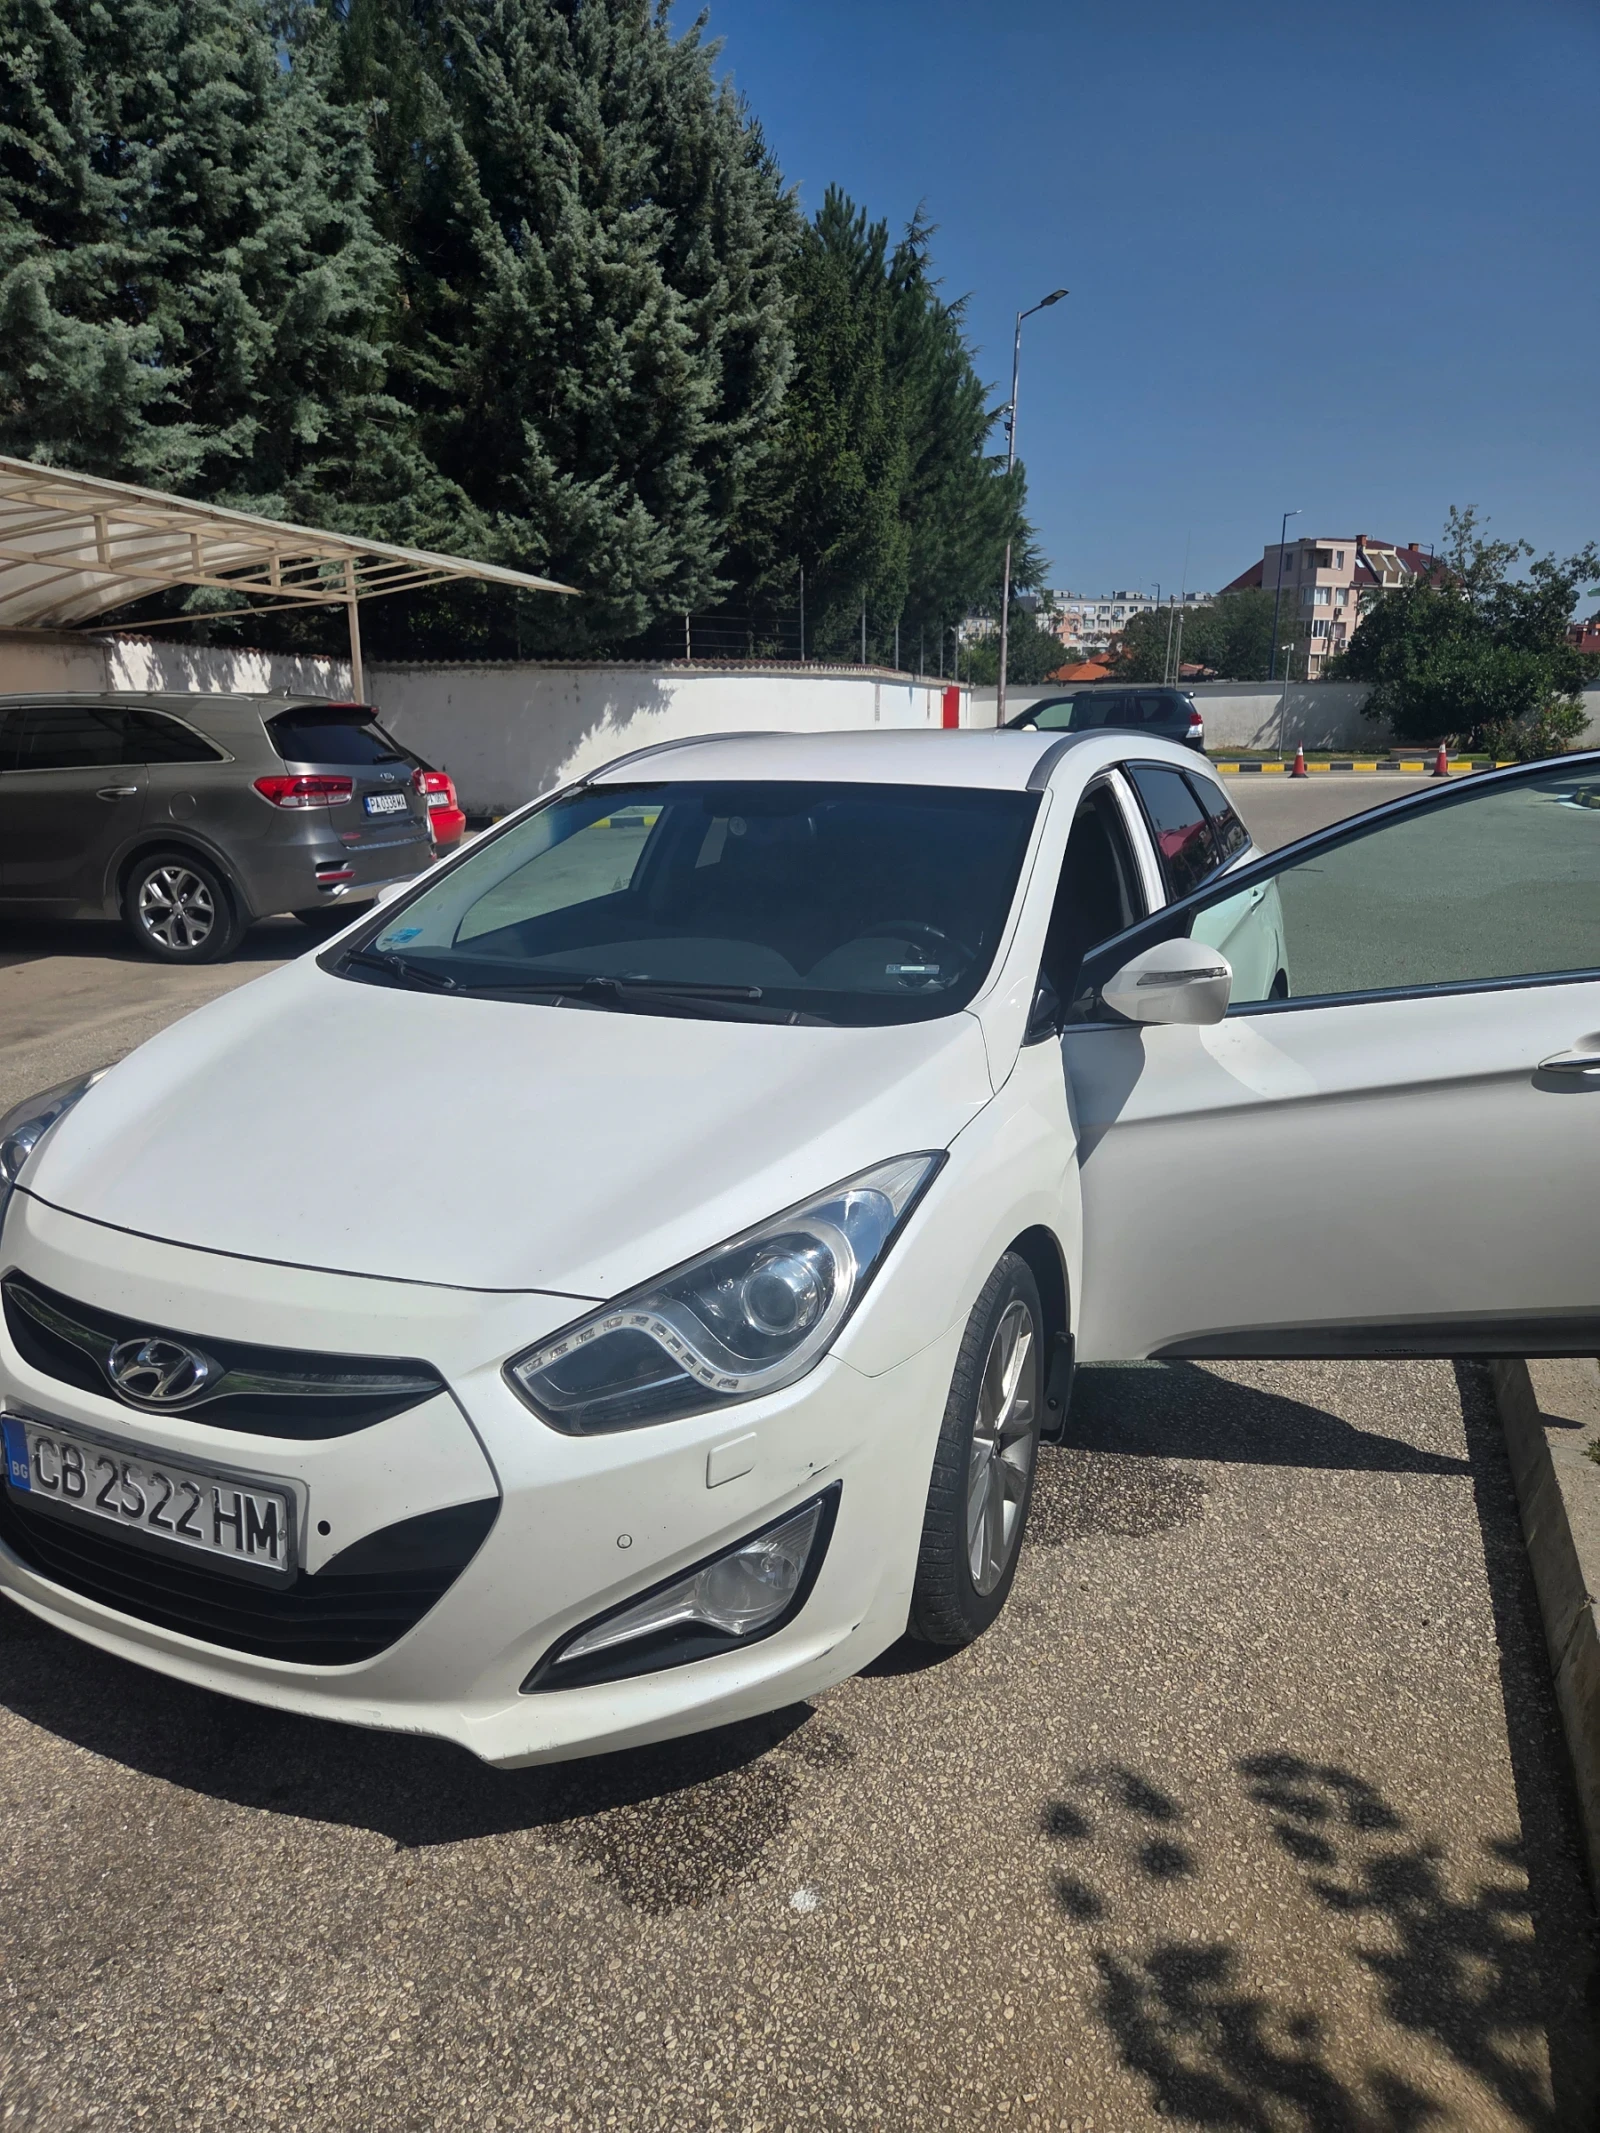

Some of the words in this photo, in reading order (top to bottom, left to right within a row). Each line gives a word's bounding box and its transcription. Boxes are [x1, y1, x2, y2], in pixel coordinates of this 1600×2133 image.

[370, 797, 381, 811] PA
[12, 1460, 28, 1478] BG
[34, 1437, 88, 1498] CB
[96, 1459, 204, 1540] 2522
[212, 1486, 280, 1561] HM
